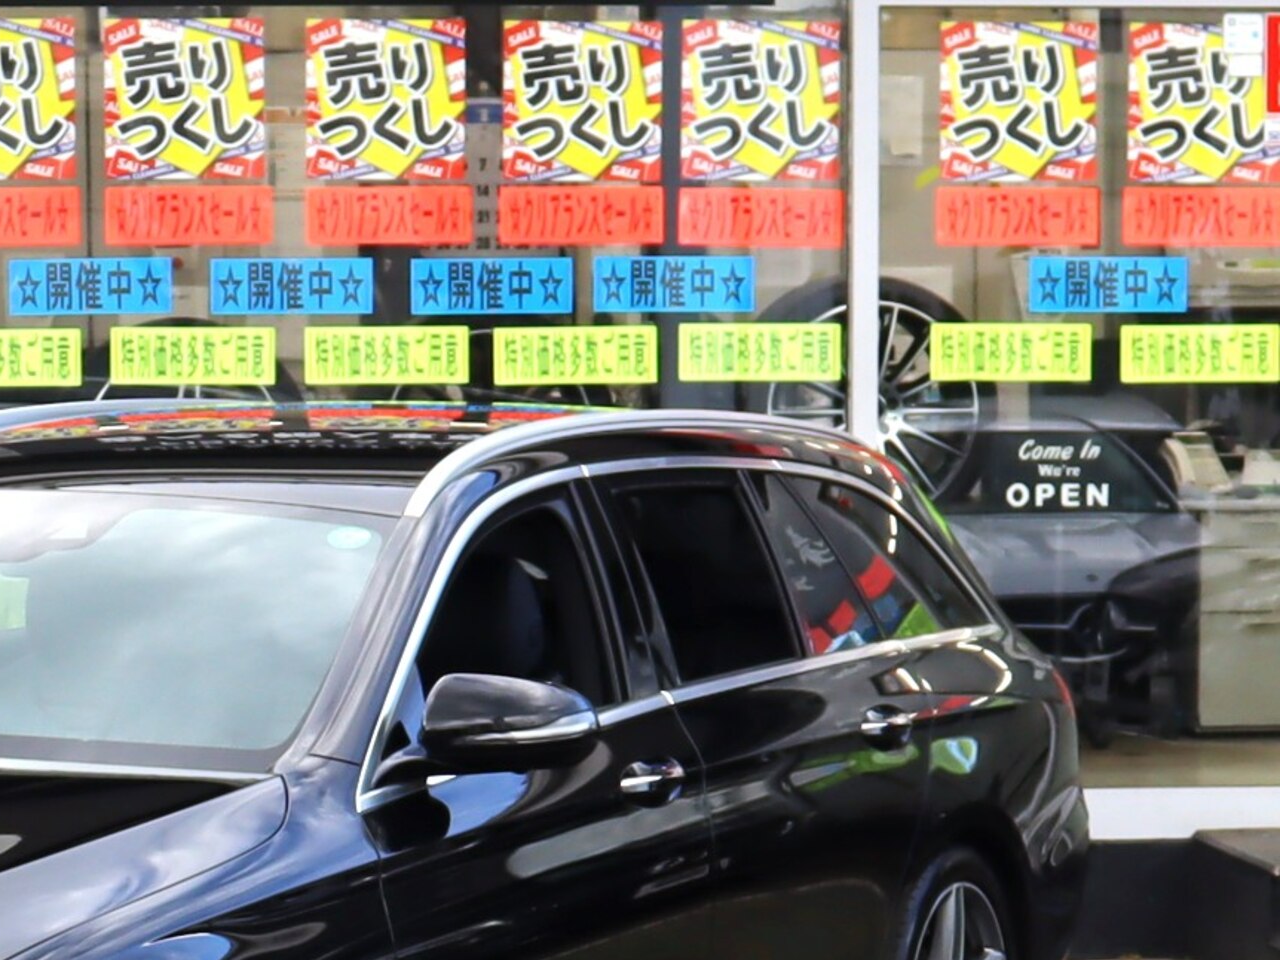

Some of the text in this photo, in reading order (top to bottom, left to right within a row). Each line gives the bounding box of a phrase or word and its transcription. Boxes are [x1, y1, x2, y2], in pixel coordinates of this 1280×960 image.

[107, 25, 136, 44] SALE
[121, 42, 228, 106] 売り
[323, 42, 429, 106] 売り
[521, 43, 625, 107] 売り
[699, 43, 803, 106] 売り
[957, 45, 1060, 108] 売り
[1146, 46, 1247, 108] 売り
[117, 97, 253, 156] つくし
[319, 98, 453, 156] つくし
[517, 100, 650, 157] つくし
[694, 100, 826, 157] つくし
[952, 101, 1084, 158] つくし
[1141, 103, 1264, 158] つくし
[46, 261, 131, 311] 開催中
[248, 262, 332, 310] 開催中
[448, 261, 532, 310] 開催中
[630, 259, 714, 307] 開催中
[1065, 260, 1148, 308] 開催中
[1018, 438, 1102, 461] Come In
[1037, 464, 1081, 477] We're
[1006, 482, 1109, 507] OPEN
